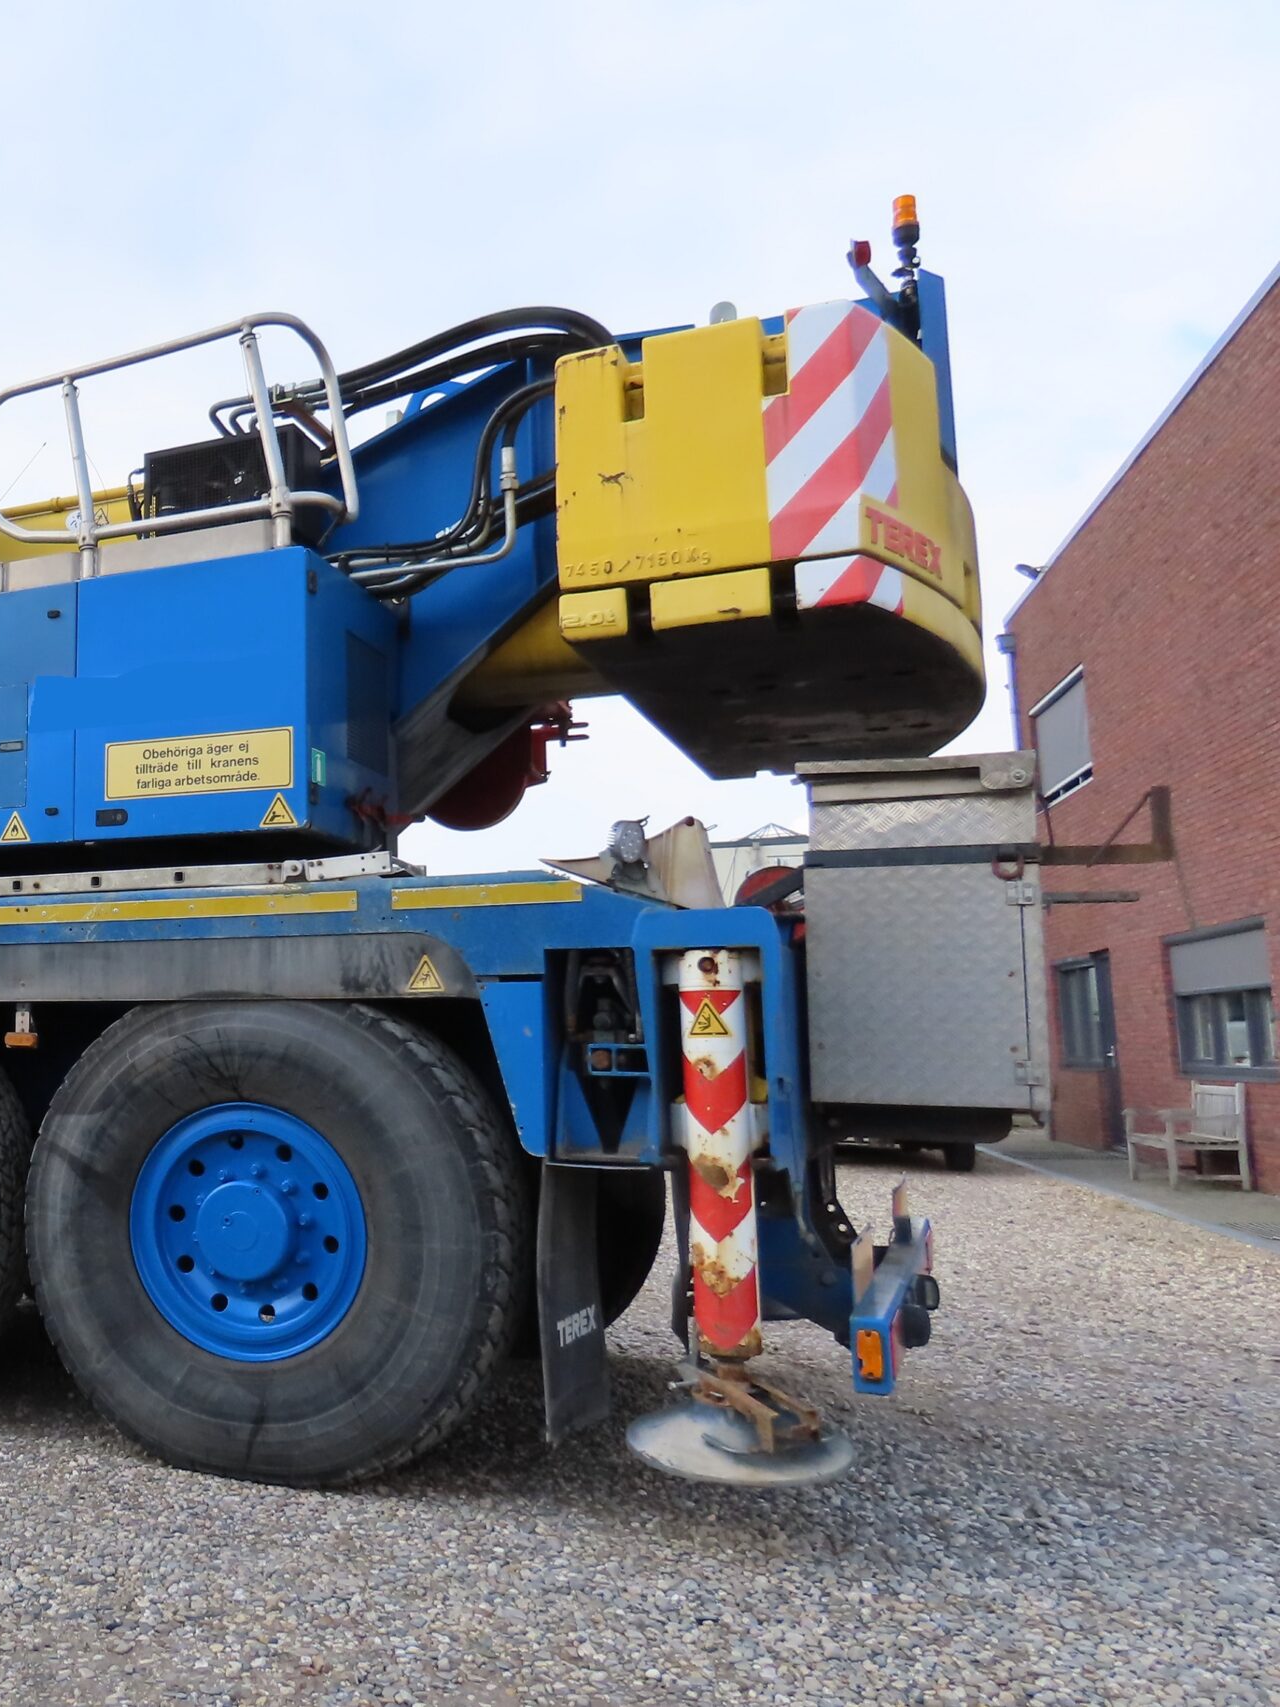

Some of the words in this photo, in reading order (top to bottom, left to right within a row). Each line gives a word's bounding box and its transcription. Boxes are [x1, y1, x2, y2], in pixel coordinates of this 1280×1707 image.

[865, 506, 942, 580] TEREX
[142, 746, 203, 760] Obehöriga
[207, 743, 233, 756] äger
[238, 740, 249, 753] ej
[135, 762, 178, 774] tillträde
[187, 758, 202, 770] till
[210, 756, 260, 769] kranens
[136, 777, 171, 790] farliga
[174, 770, 261, 786] arbetsområde.
[557, 1304, 596, 1347] TEREX
